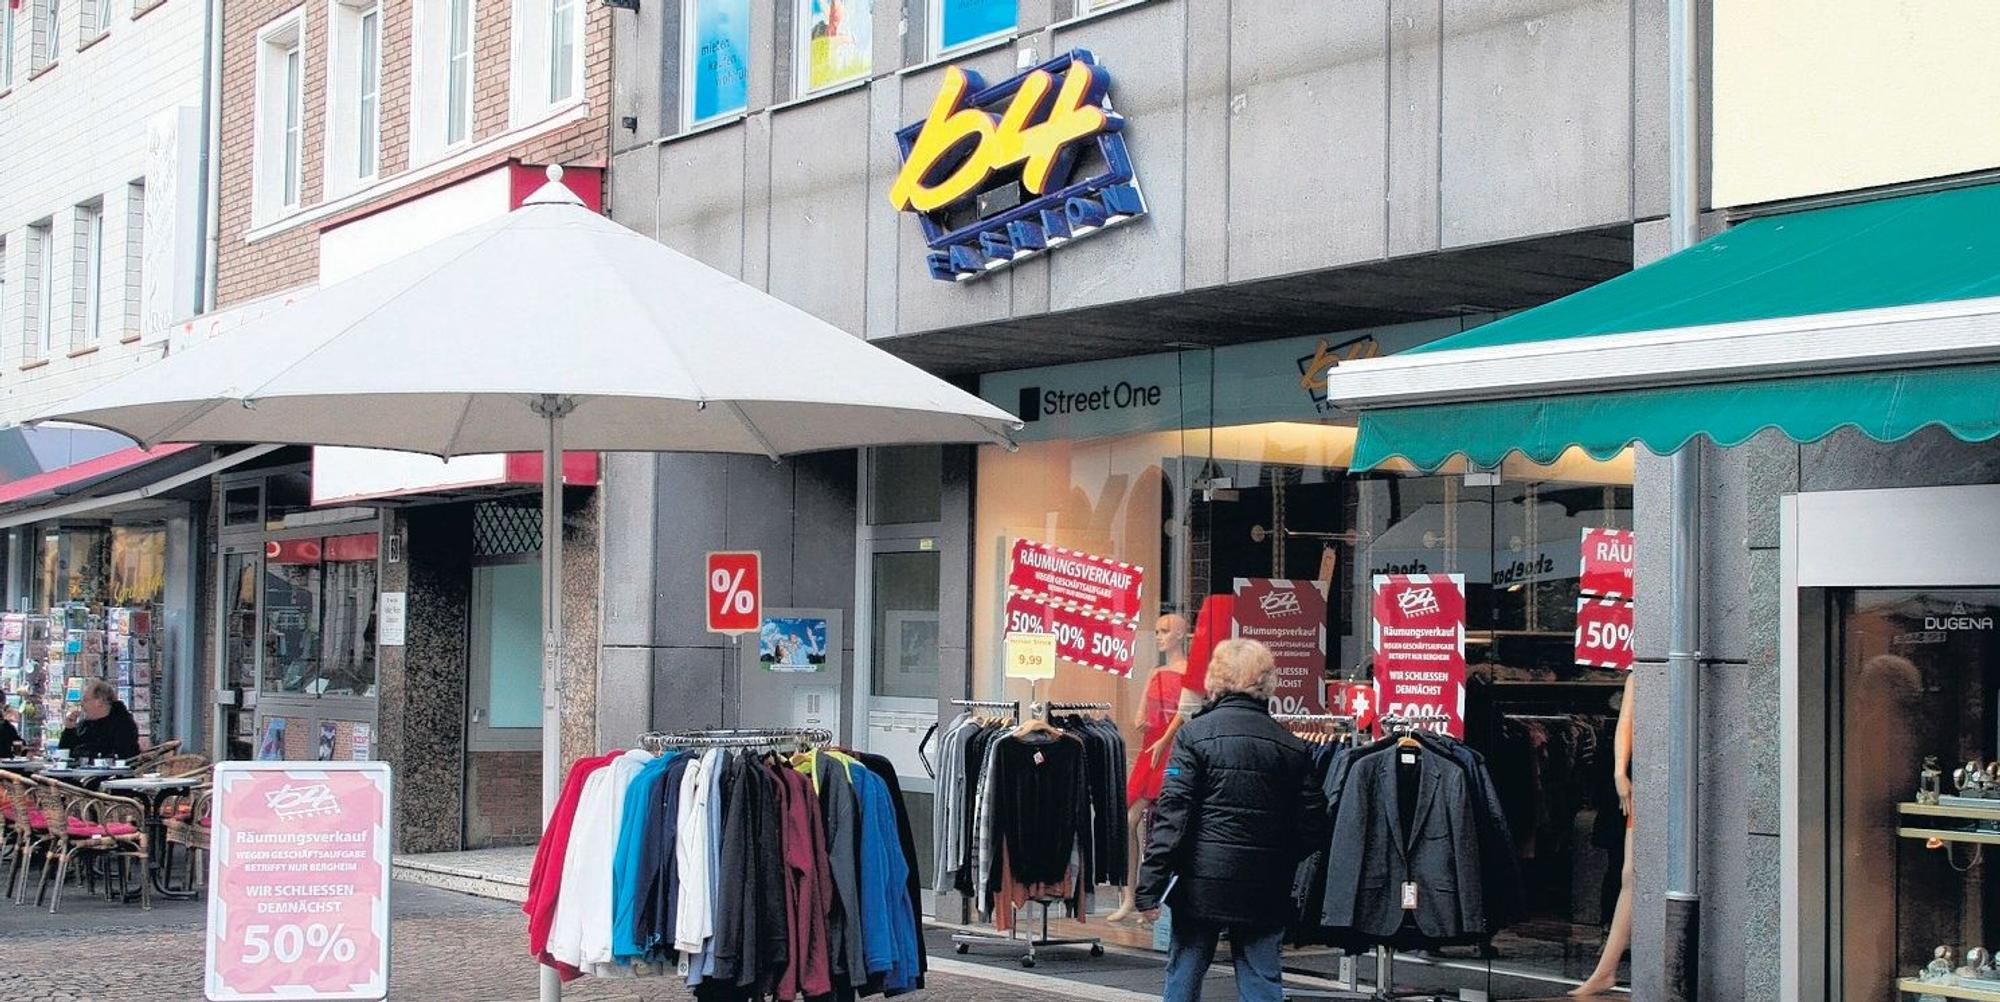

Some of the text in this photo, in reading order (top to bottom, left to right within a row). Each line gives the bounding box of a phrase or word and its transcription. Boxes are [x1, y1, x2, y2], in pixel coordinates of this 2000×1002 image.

[889, 64, 1108, 212] b4
[926, 185, 1146, 281] FASHION
[1043, 381, 1161, 415] Street One
[1020, 548, 1132, 590] RÄUMUNGSVERKAUF
[711, 568, 755, 615] %
[1925, 617, 1993, 630] DUGENA
[1011, 610, 1128, 662] 50% 50% 50%
[1242, 626, 1316, 638] Räumungsverkauf
[1383, 626, 1455, 639] Räumungsverkauf
[1018, 654, 1042, 666] 9,99
[1389, 671, 1449, 682] WIR SCHLIESSEN
[1395, 684, 1442, 696] DEMNÄCHST
[236, 830, 368, 845] Räumungsverkauf
[236, 849, 367, 859] WEGEN GESCHÄFTSAUFGABE
[245, 863, 357, 872] BETRIFFT NUR BERGHEIM
[245, 884, 354, 897] WIR SCHLIESSEN
[258, 901, 342, 913] DEMNÄCHST
[241, 923, 357, 964] 50%
